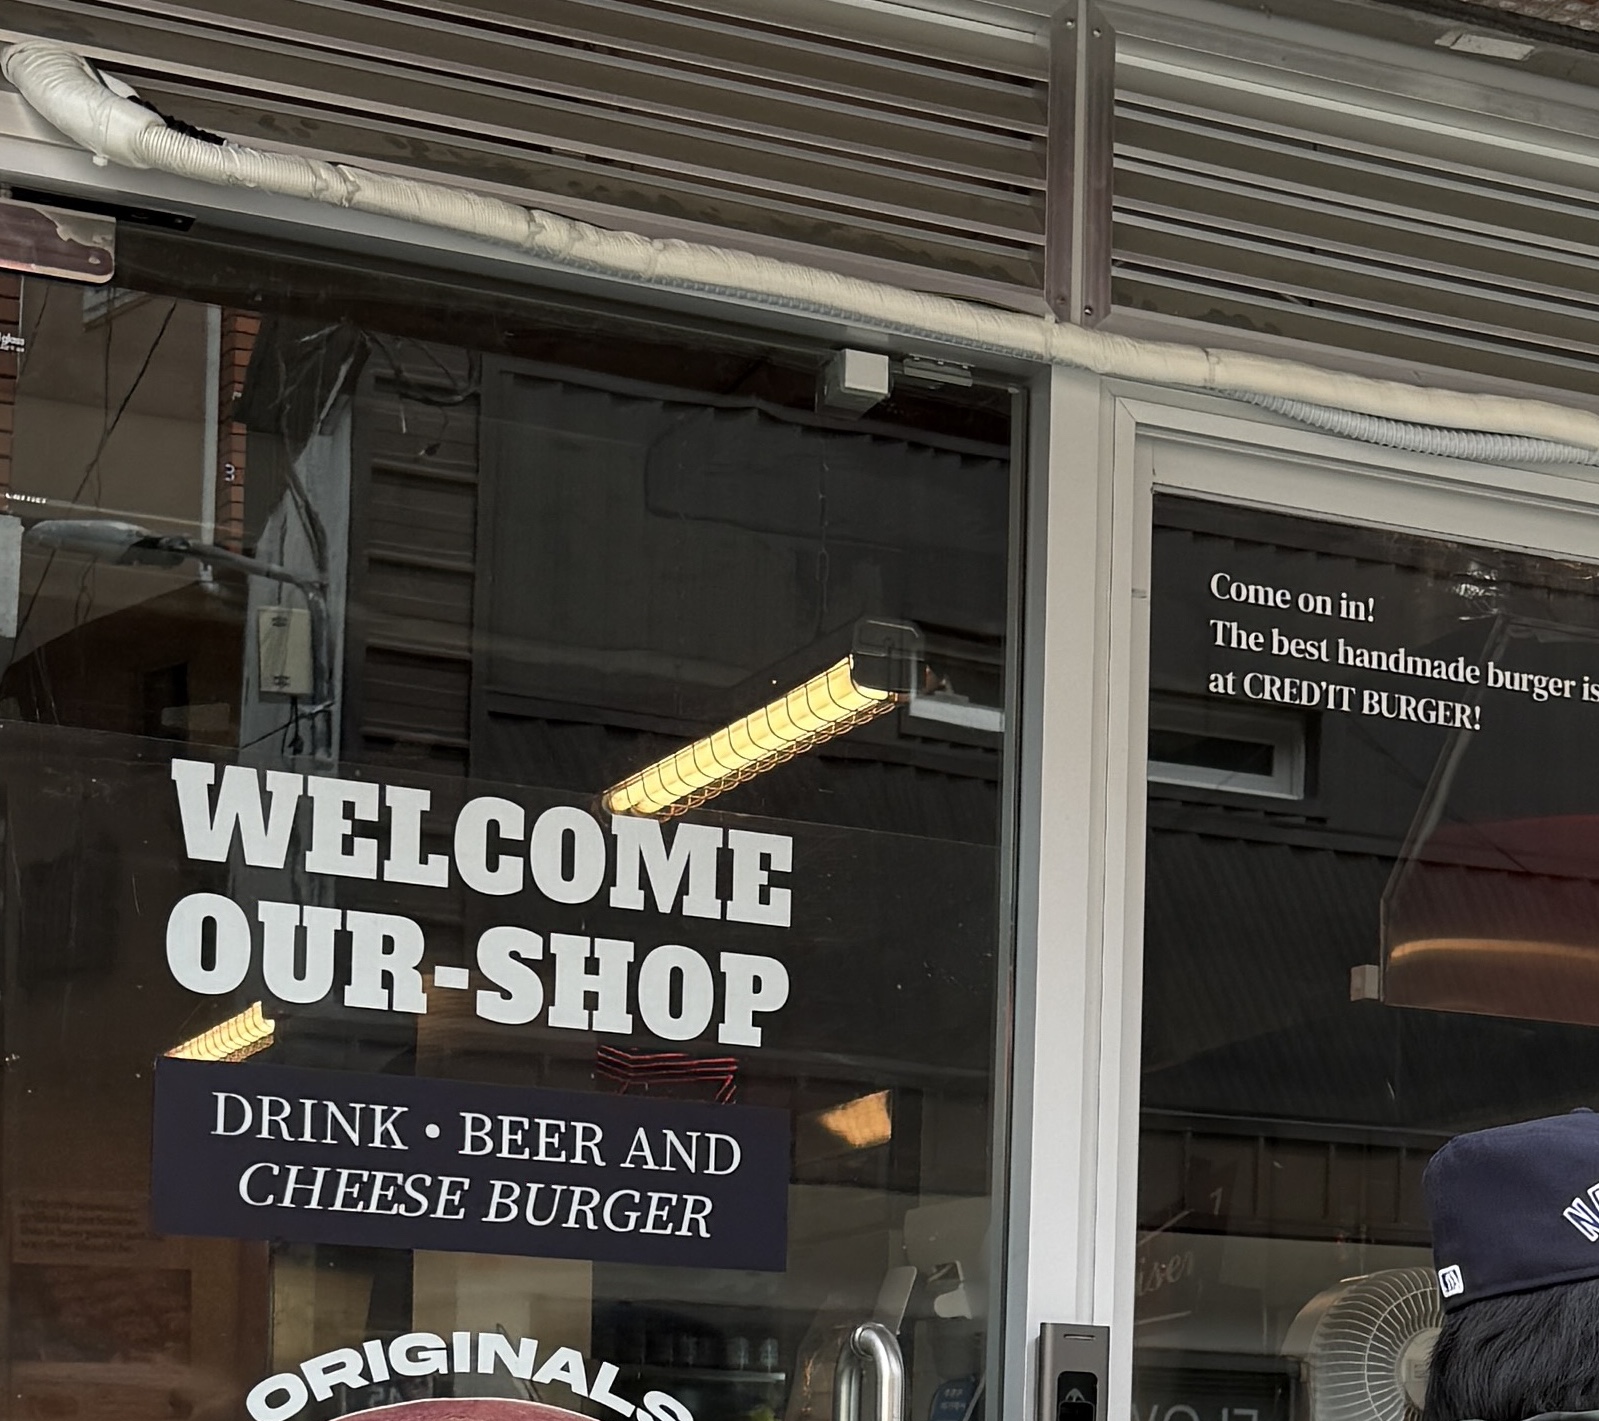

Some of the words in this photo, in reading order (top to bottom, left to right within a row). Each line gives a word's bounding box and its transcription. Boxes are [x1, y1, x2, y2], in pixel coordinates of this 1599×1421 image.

[1210, 572, 1291, 611] Come
[1296, 588, 1334, 615] on
[1339, 590, 1374, 622] in!
[1208, 669, 1237, 696] at
[1243, 672, 1356, 713] CRED'IT
[1362, 690, 1481, 731] BURGER!
[1210, 619, 1265, 653] The
[1272, 629, 1329, 663] best
[1337, 637, 1481, 685] handmade
[1487, 659, 1576, 702] burger
[171, 758, 793, 927] WELCOME
[166, 892, 790, 1048] OUR-SHOP
[211, 1091, 409, 1151] DRINK
[458, 1112, 607, 1168] BEER
[620, 1126, 743, 1176] AND
[238, 1161, 470, 1223] CHEESE
[482, 1180, 714, 1238] BURGER
